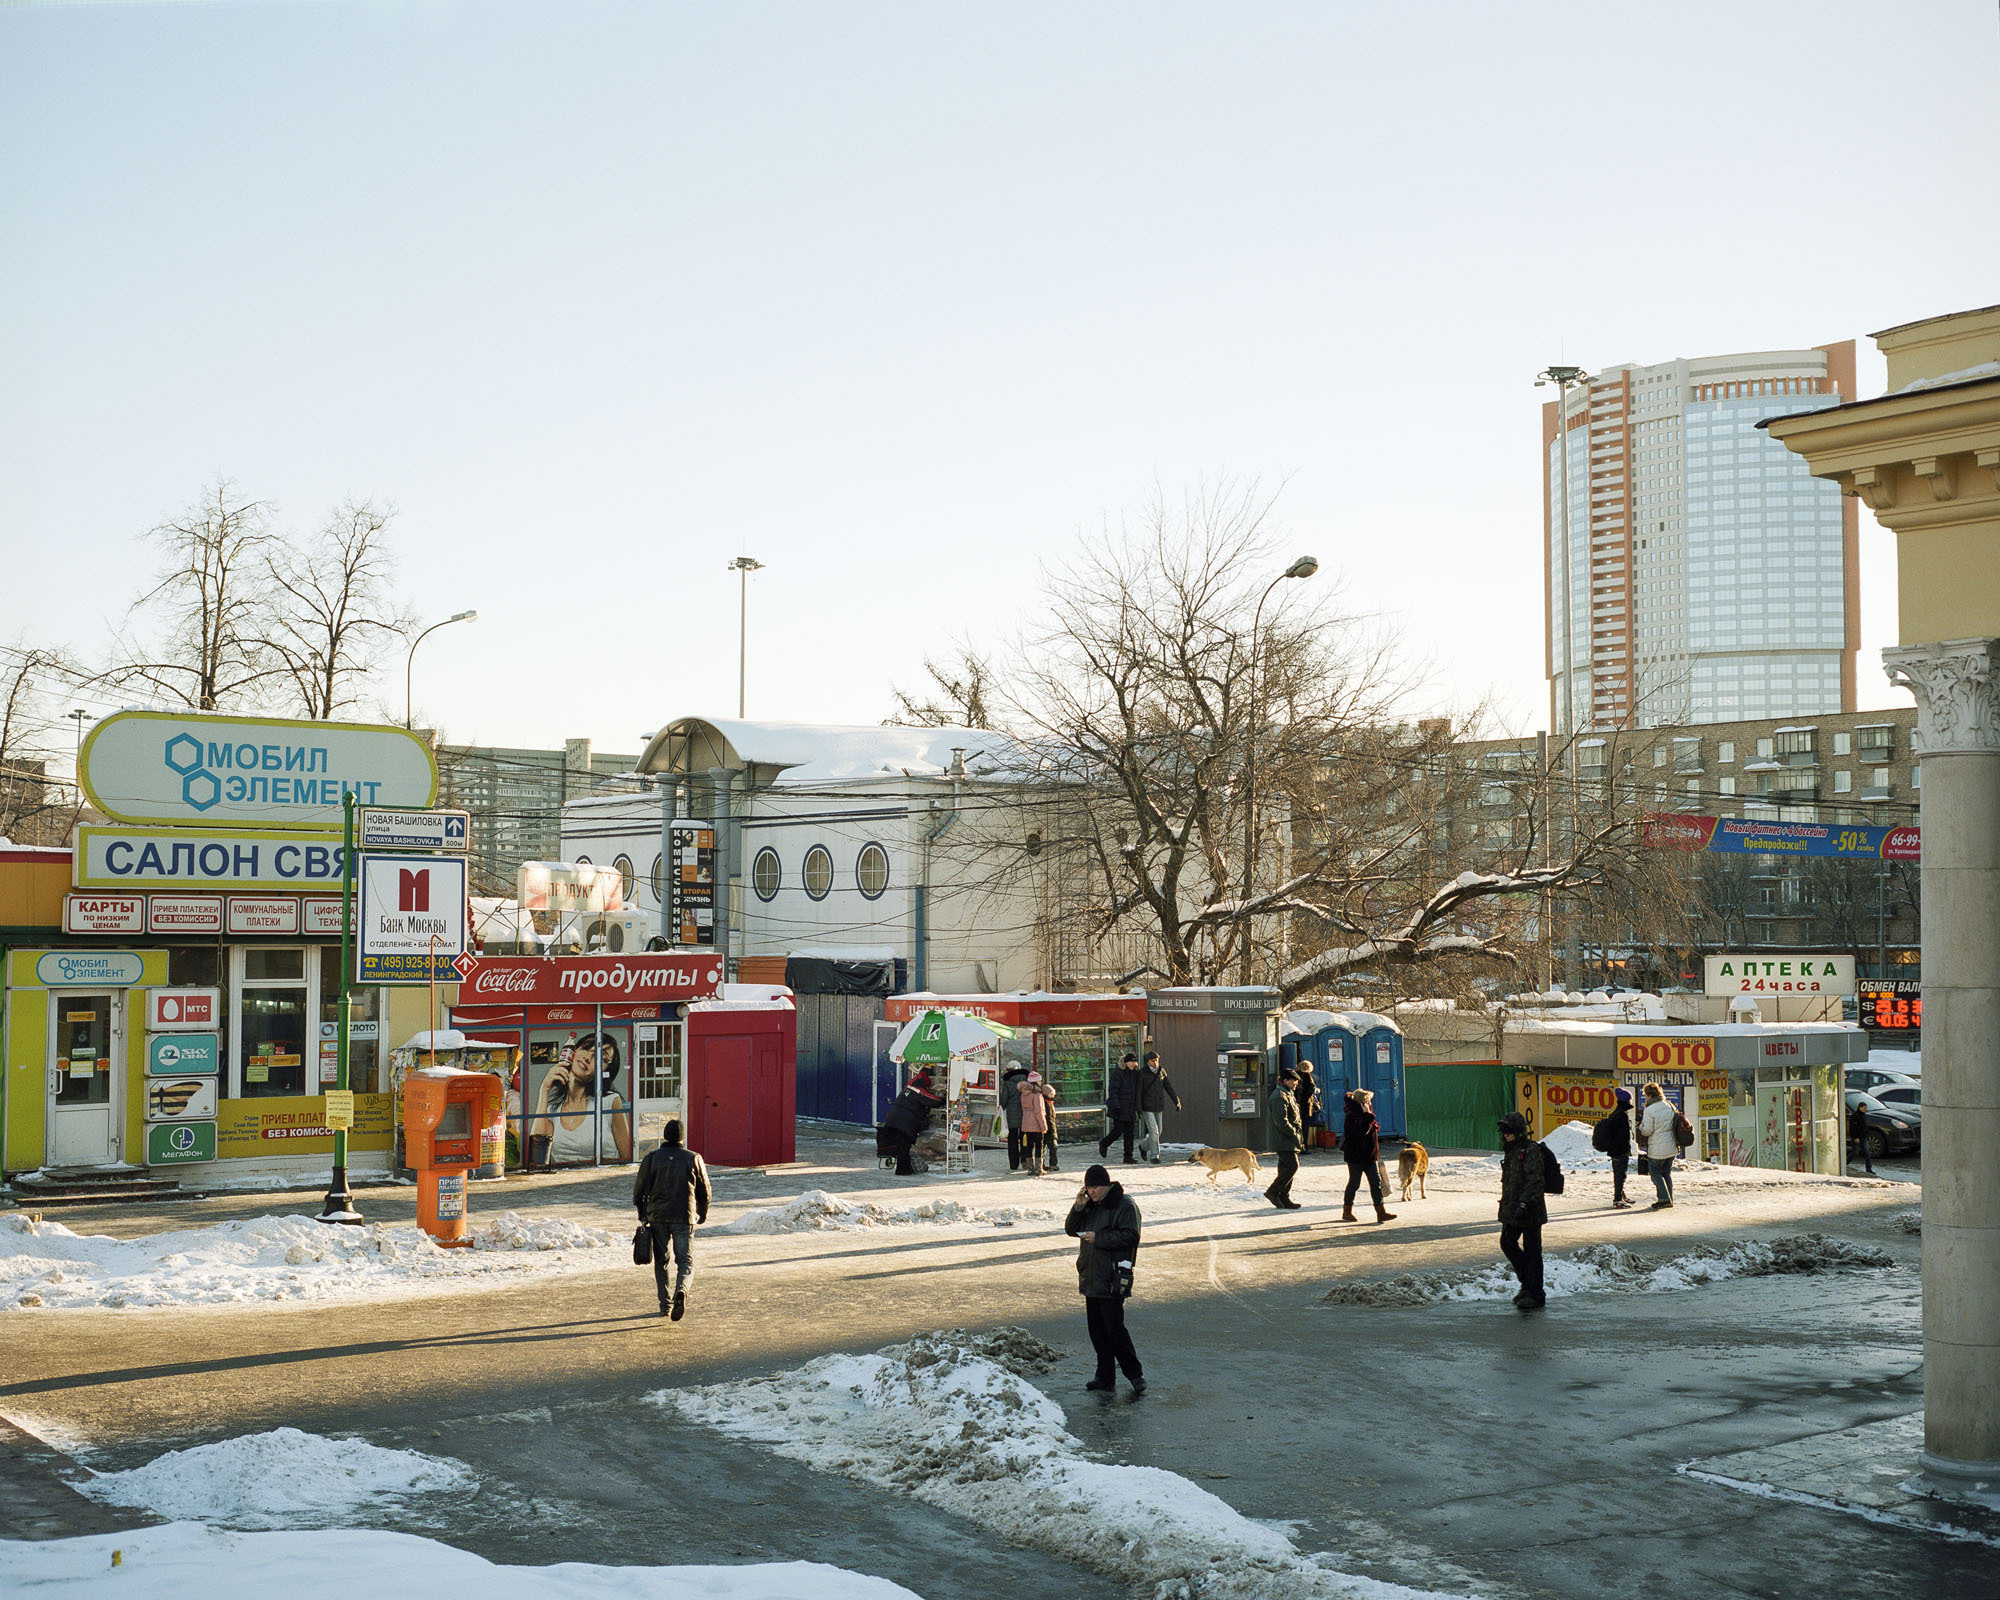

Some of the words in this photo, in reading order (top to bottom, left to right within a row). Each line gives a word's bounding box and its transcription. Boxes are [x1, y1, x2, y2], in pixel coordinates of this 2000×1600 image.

[207, 742, 328, 773] МОБИЛ
[225, 775, 382, 805] ЭЛЕМЕНТ
[366, 814, 393, 825] НОВАЯ
[394, 815, 443, 827] БАШИЛОВКА
[1724, 821, 1752, 835] Новый
[1751, 823, 1782, 837] фитнес
[1794, 826, 1829, 838] бассейна
[366, 835, 393, 843] NOVAYA
[394, 837, 435, 845] BASHILOVKA
[446, 840, 463, 848] 500м
[1743, 837, 1808, 853] Предпродажи!!!
[105, 841, 259, 877] САЛОН
[79, 901, 134, 912] КАРТЫ
[153, 905, 178, 913] ПРИЕМ
[233, 905, 294, 914] КОММУНАЛЬНЫЕ
[174, 915, 215, 923] КОМИССИИ
[246, 917, 281, 926] ПЛАТЕЖИ
[380, 915, 404, 934] Банк
[407, 915, 447, 934] Москвы
[71, 960, 108, 968] МОБИЛ
[381, 956, 405, 971] (495)
[1720, 962, 1838, 976] АПТЕКА
[77, 969, 125, 978] ЭЛЕМЕНТ
[364, 971, 423, 979] ЛЕНИНГРАДСКИЙ
[560, 963, 698, 994] продукты
[1860, 981, 1896, 992] ОБМЕН
[187, 1005, 208, 1013] МТС
[1224, 999, 1262, 1009] ПРОЕЗДНЫЕ
[1620, 1043, 1712, 1065] ФОТО
[1765, 1042, 1799, 1056] ЦВЕТЫ
[1564, 1078, 1596, 1086] СРОЧНОЕ
[1700, 1078, 1727, 1090] ФОТО
[1547, 1085, 1615, 1109] ФОТО
[1702, 1103, 1726, 1111] КСЕРОКС
[262, 1115, 296, 1125] ПРИЕМ
[298, 1111, 326, 1123] ПЛАТ
[1565, 1109, 1607, 1117] ДОКУМЕНТЫ
[267, 1130, 287, 1138] БЕЗ
